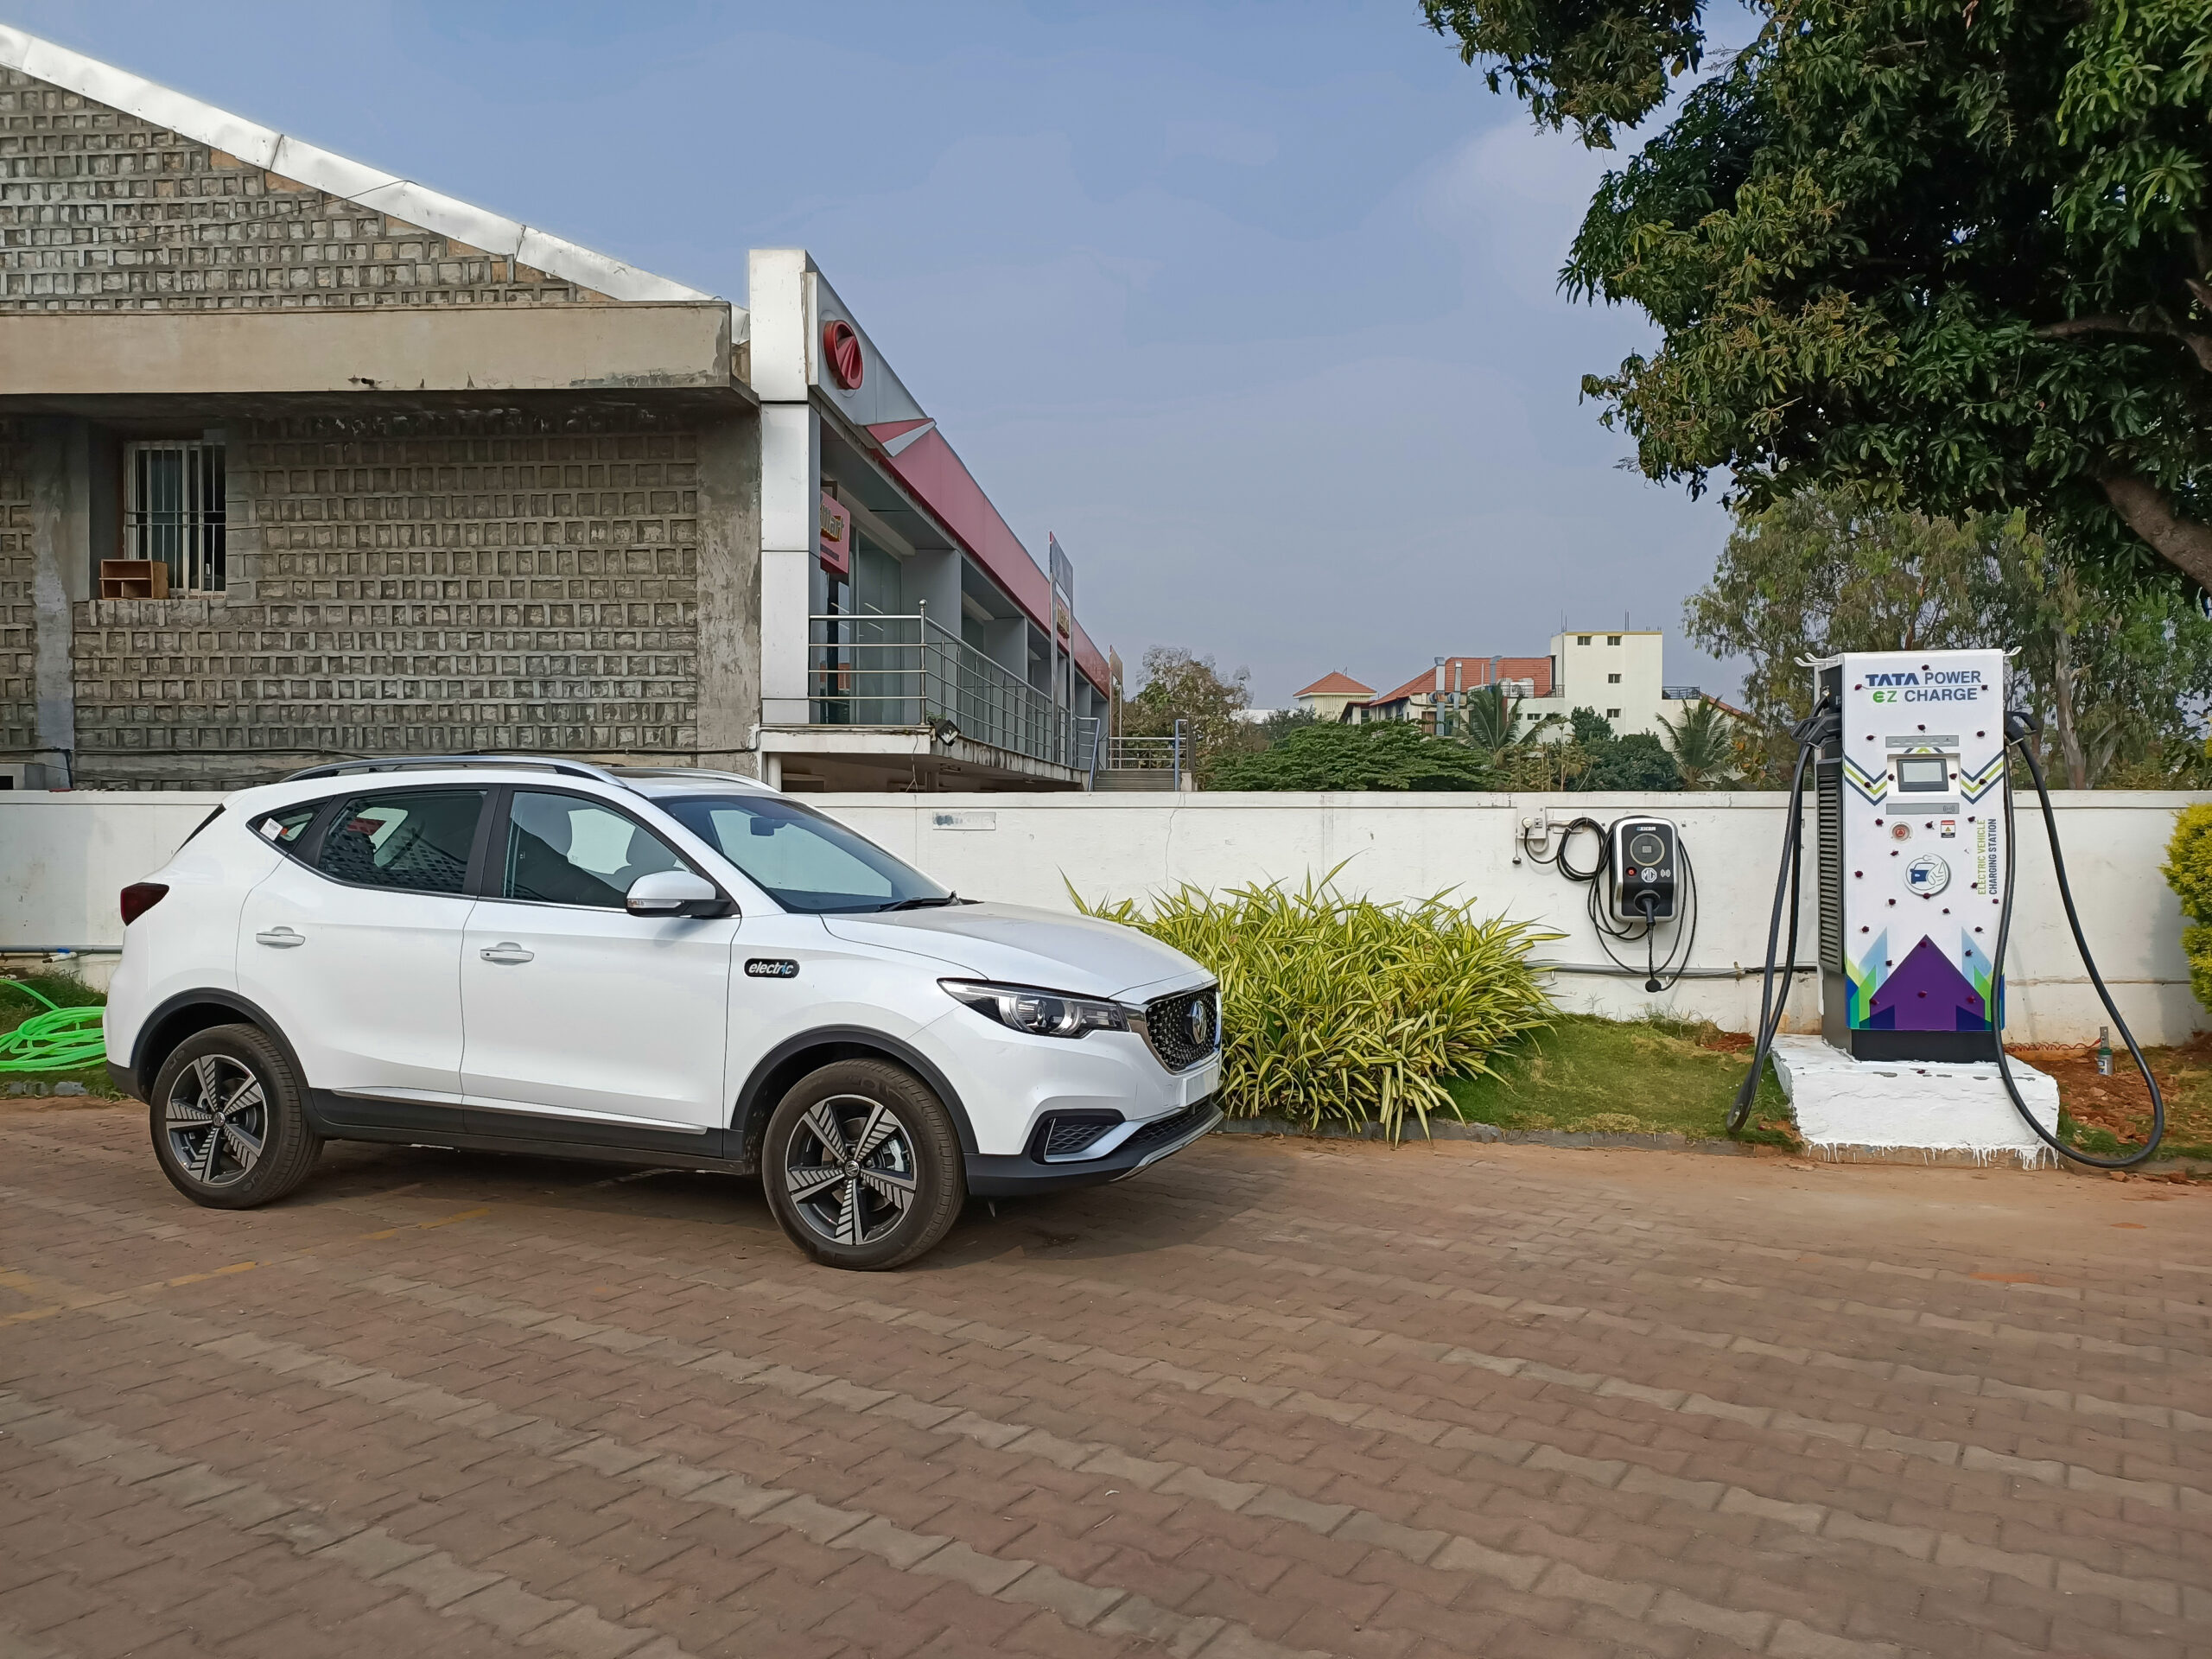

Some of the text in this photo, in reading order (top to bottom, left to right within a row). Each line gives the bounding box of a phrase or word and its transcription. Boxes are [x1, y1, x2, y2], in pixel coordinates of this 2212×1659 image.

[1866, 671, 1981, 687] TATA POWER
[1904, 688, 1978, 702] CHARGE
[1977, 819, 1986, 895] ELECTRIC VEHICLE
[1987, 818, 1998, 895] CHARGING STATION
[1643, 868, 1656, 881] MG
[748, 961, 794, 975] electric
